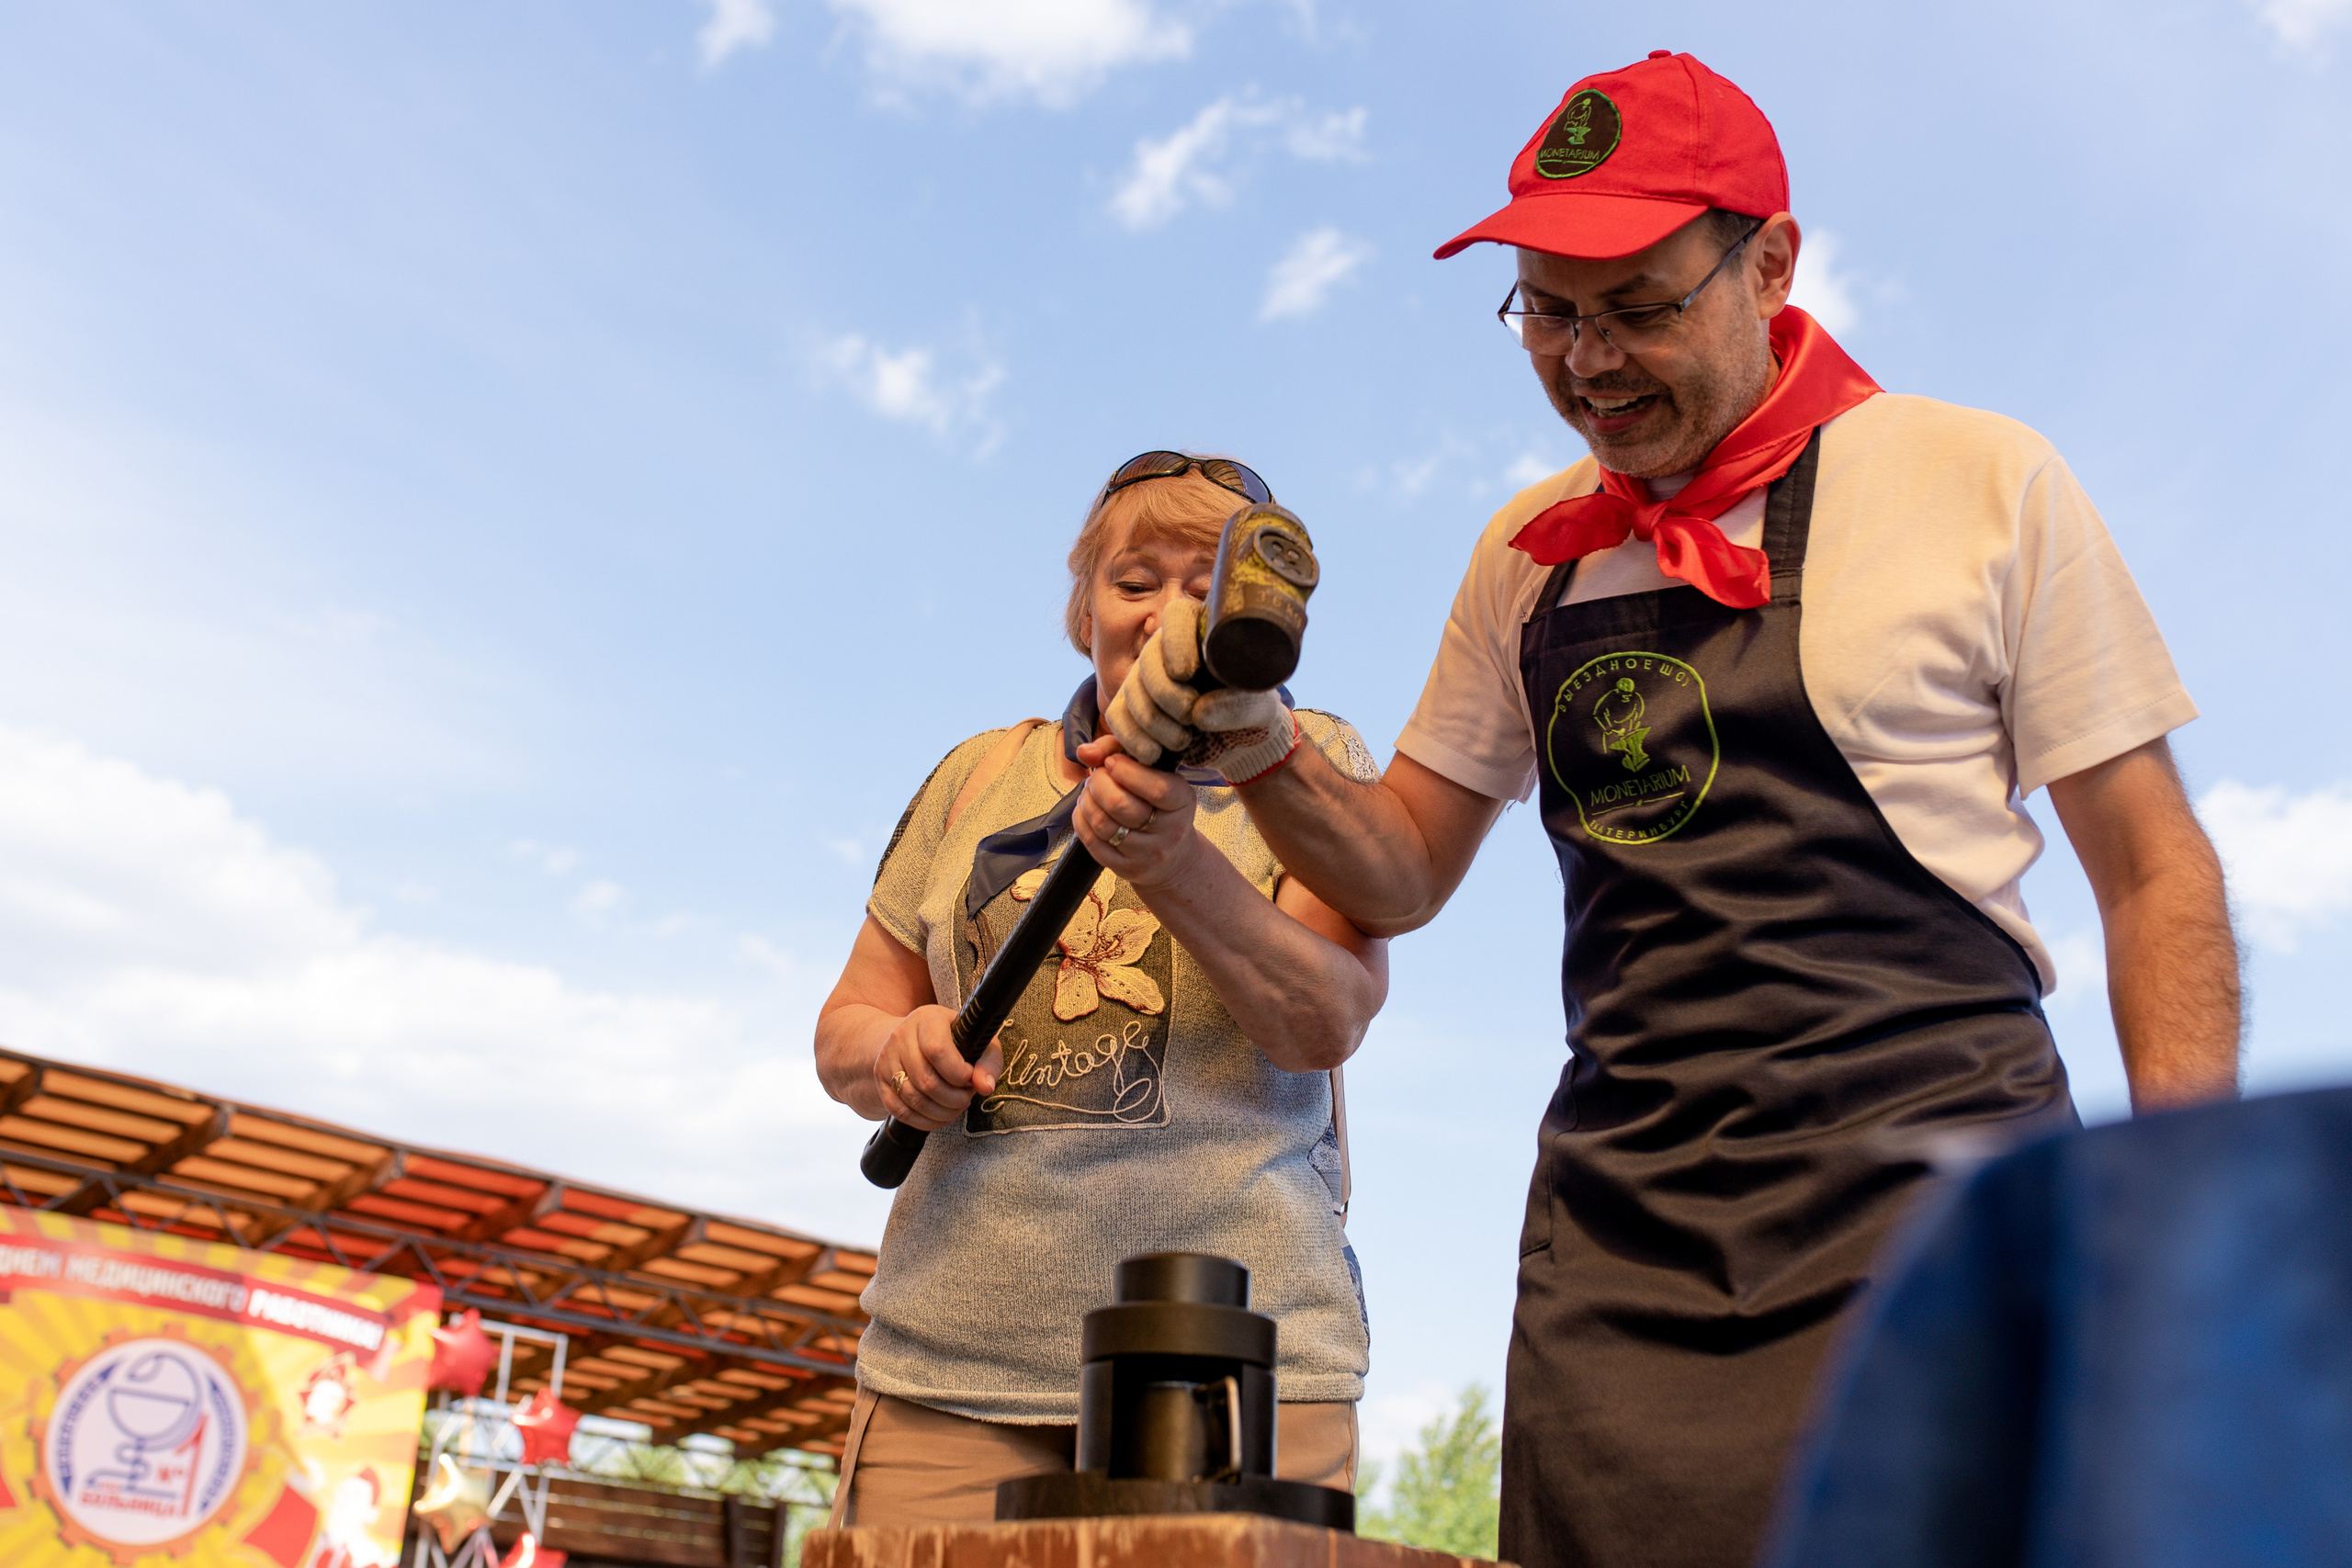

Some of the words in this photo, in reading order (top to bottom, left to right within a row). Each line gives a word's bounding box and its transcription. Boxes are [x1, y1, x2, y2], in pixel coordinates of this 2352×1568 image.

[1539, 147, 1600, 161] MONETARIUM
[1590, 764, 1691, 807] MONETARIUM
[992, 1020, 1160, 1117] intage
